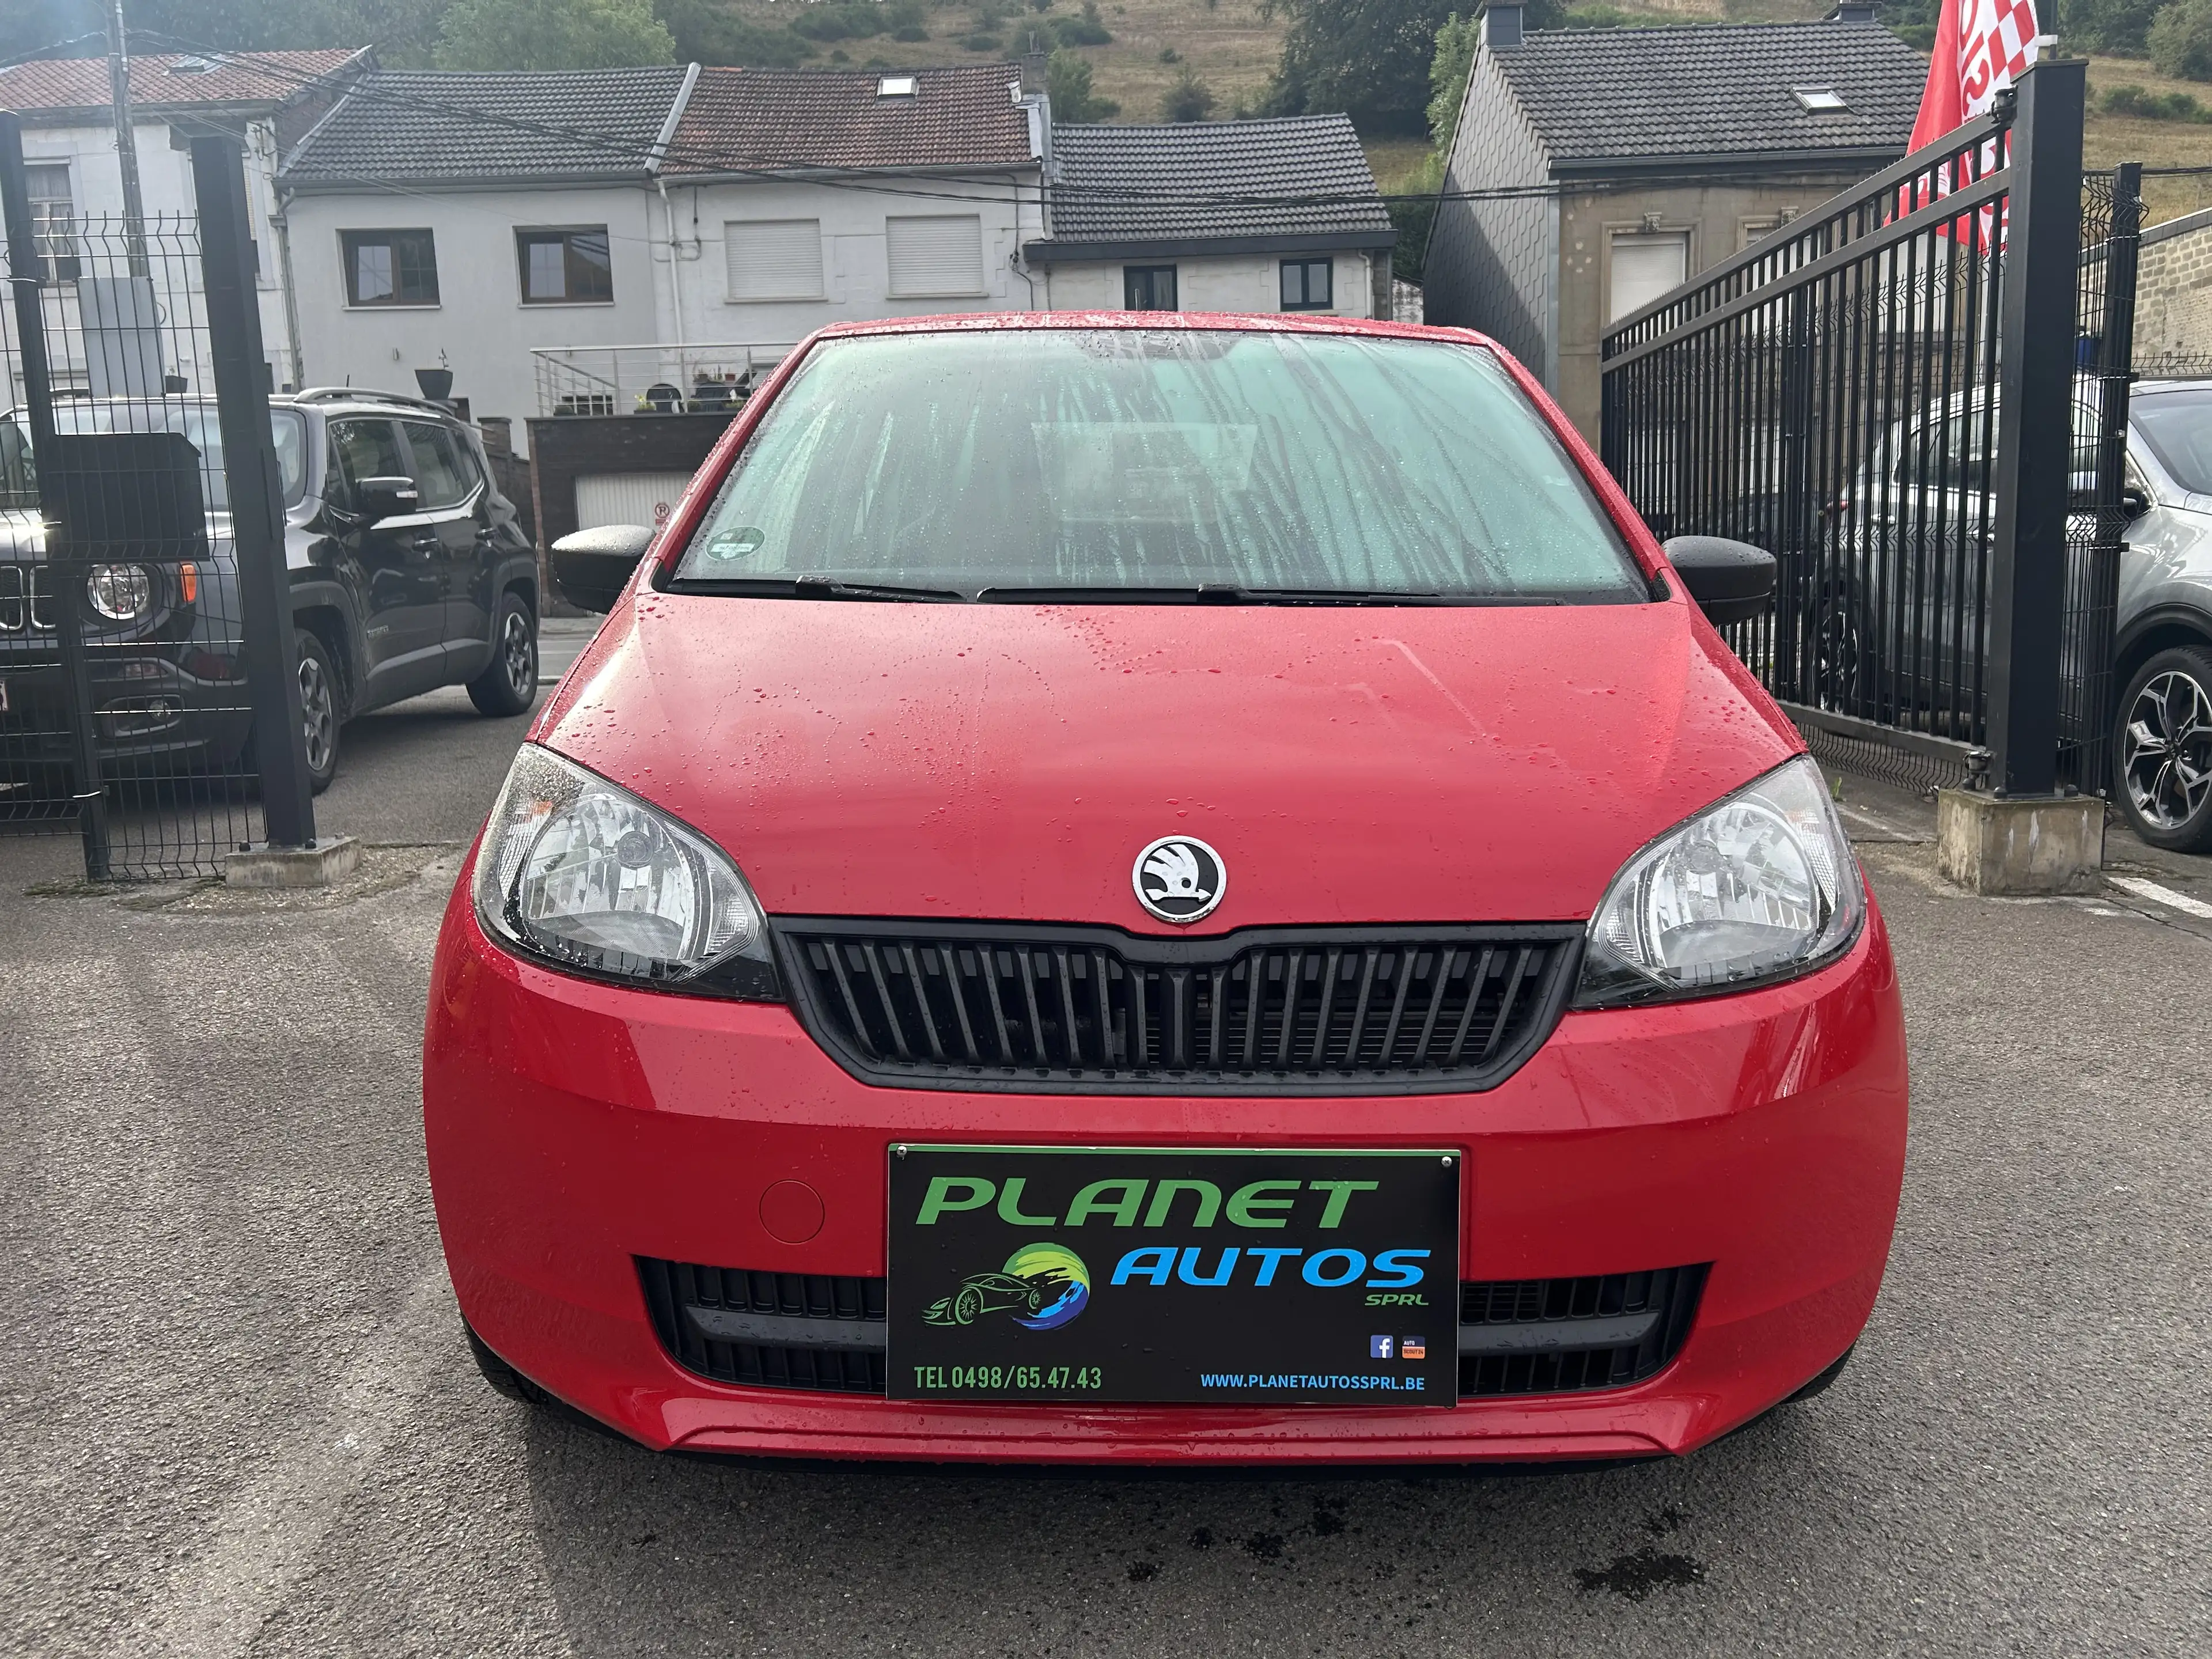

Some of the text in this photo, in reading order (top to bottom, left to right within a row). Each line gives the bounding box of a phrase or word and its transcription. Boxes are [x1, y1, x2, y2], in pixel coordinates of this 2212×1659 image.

[915, 1177, 1379, 1228] PLANET
[1110, 1247, 1431, 1288] AUTOS
[1365, 1294, 1429, 1306] SPRL
[914, 1366, 1101, 1389] TEL 0498/65.47.43
[1200, 1374, 1425, 1391] WWW.PLANETAUTOSSPRL.BE
